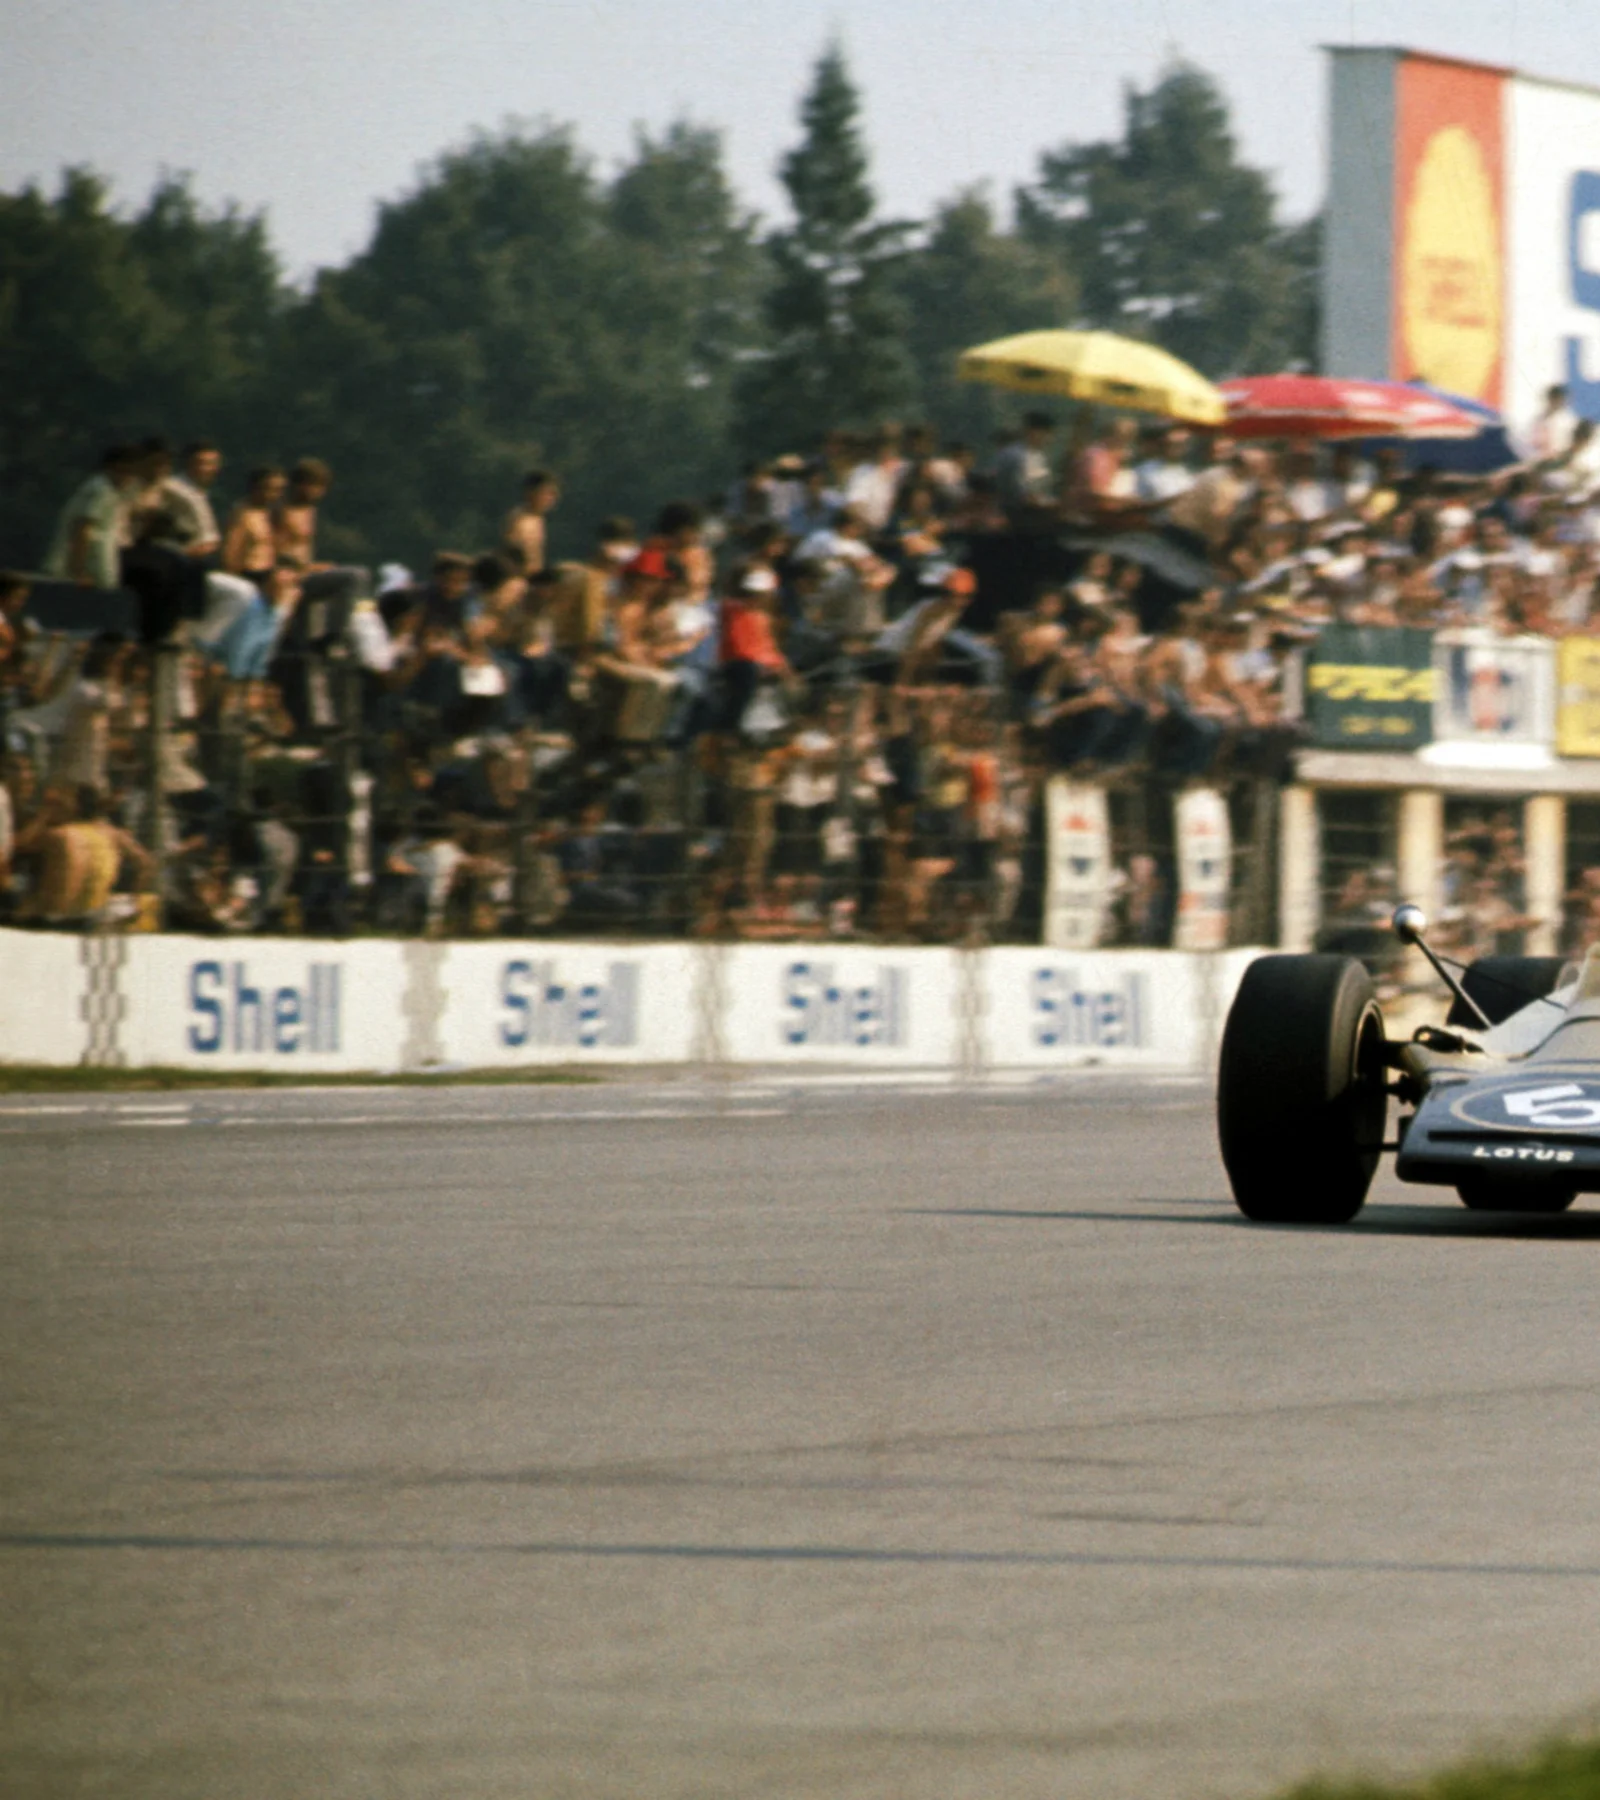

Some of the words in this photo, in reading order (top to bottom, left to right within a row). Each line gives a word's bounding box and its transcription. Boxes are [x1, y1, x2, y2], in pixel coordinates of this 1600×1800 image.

[189, 960, 341, 1053] Shell
[502, 960, 639, 1047] Shell
[783, 961, 909, 1047] Shell
[1473, 1146, 1575, 1162] LOTUS
